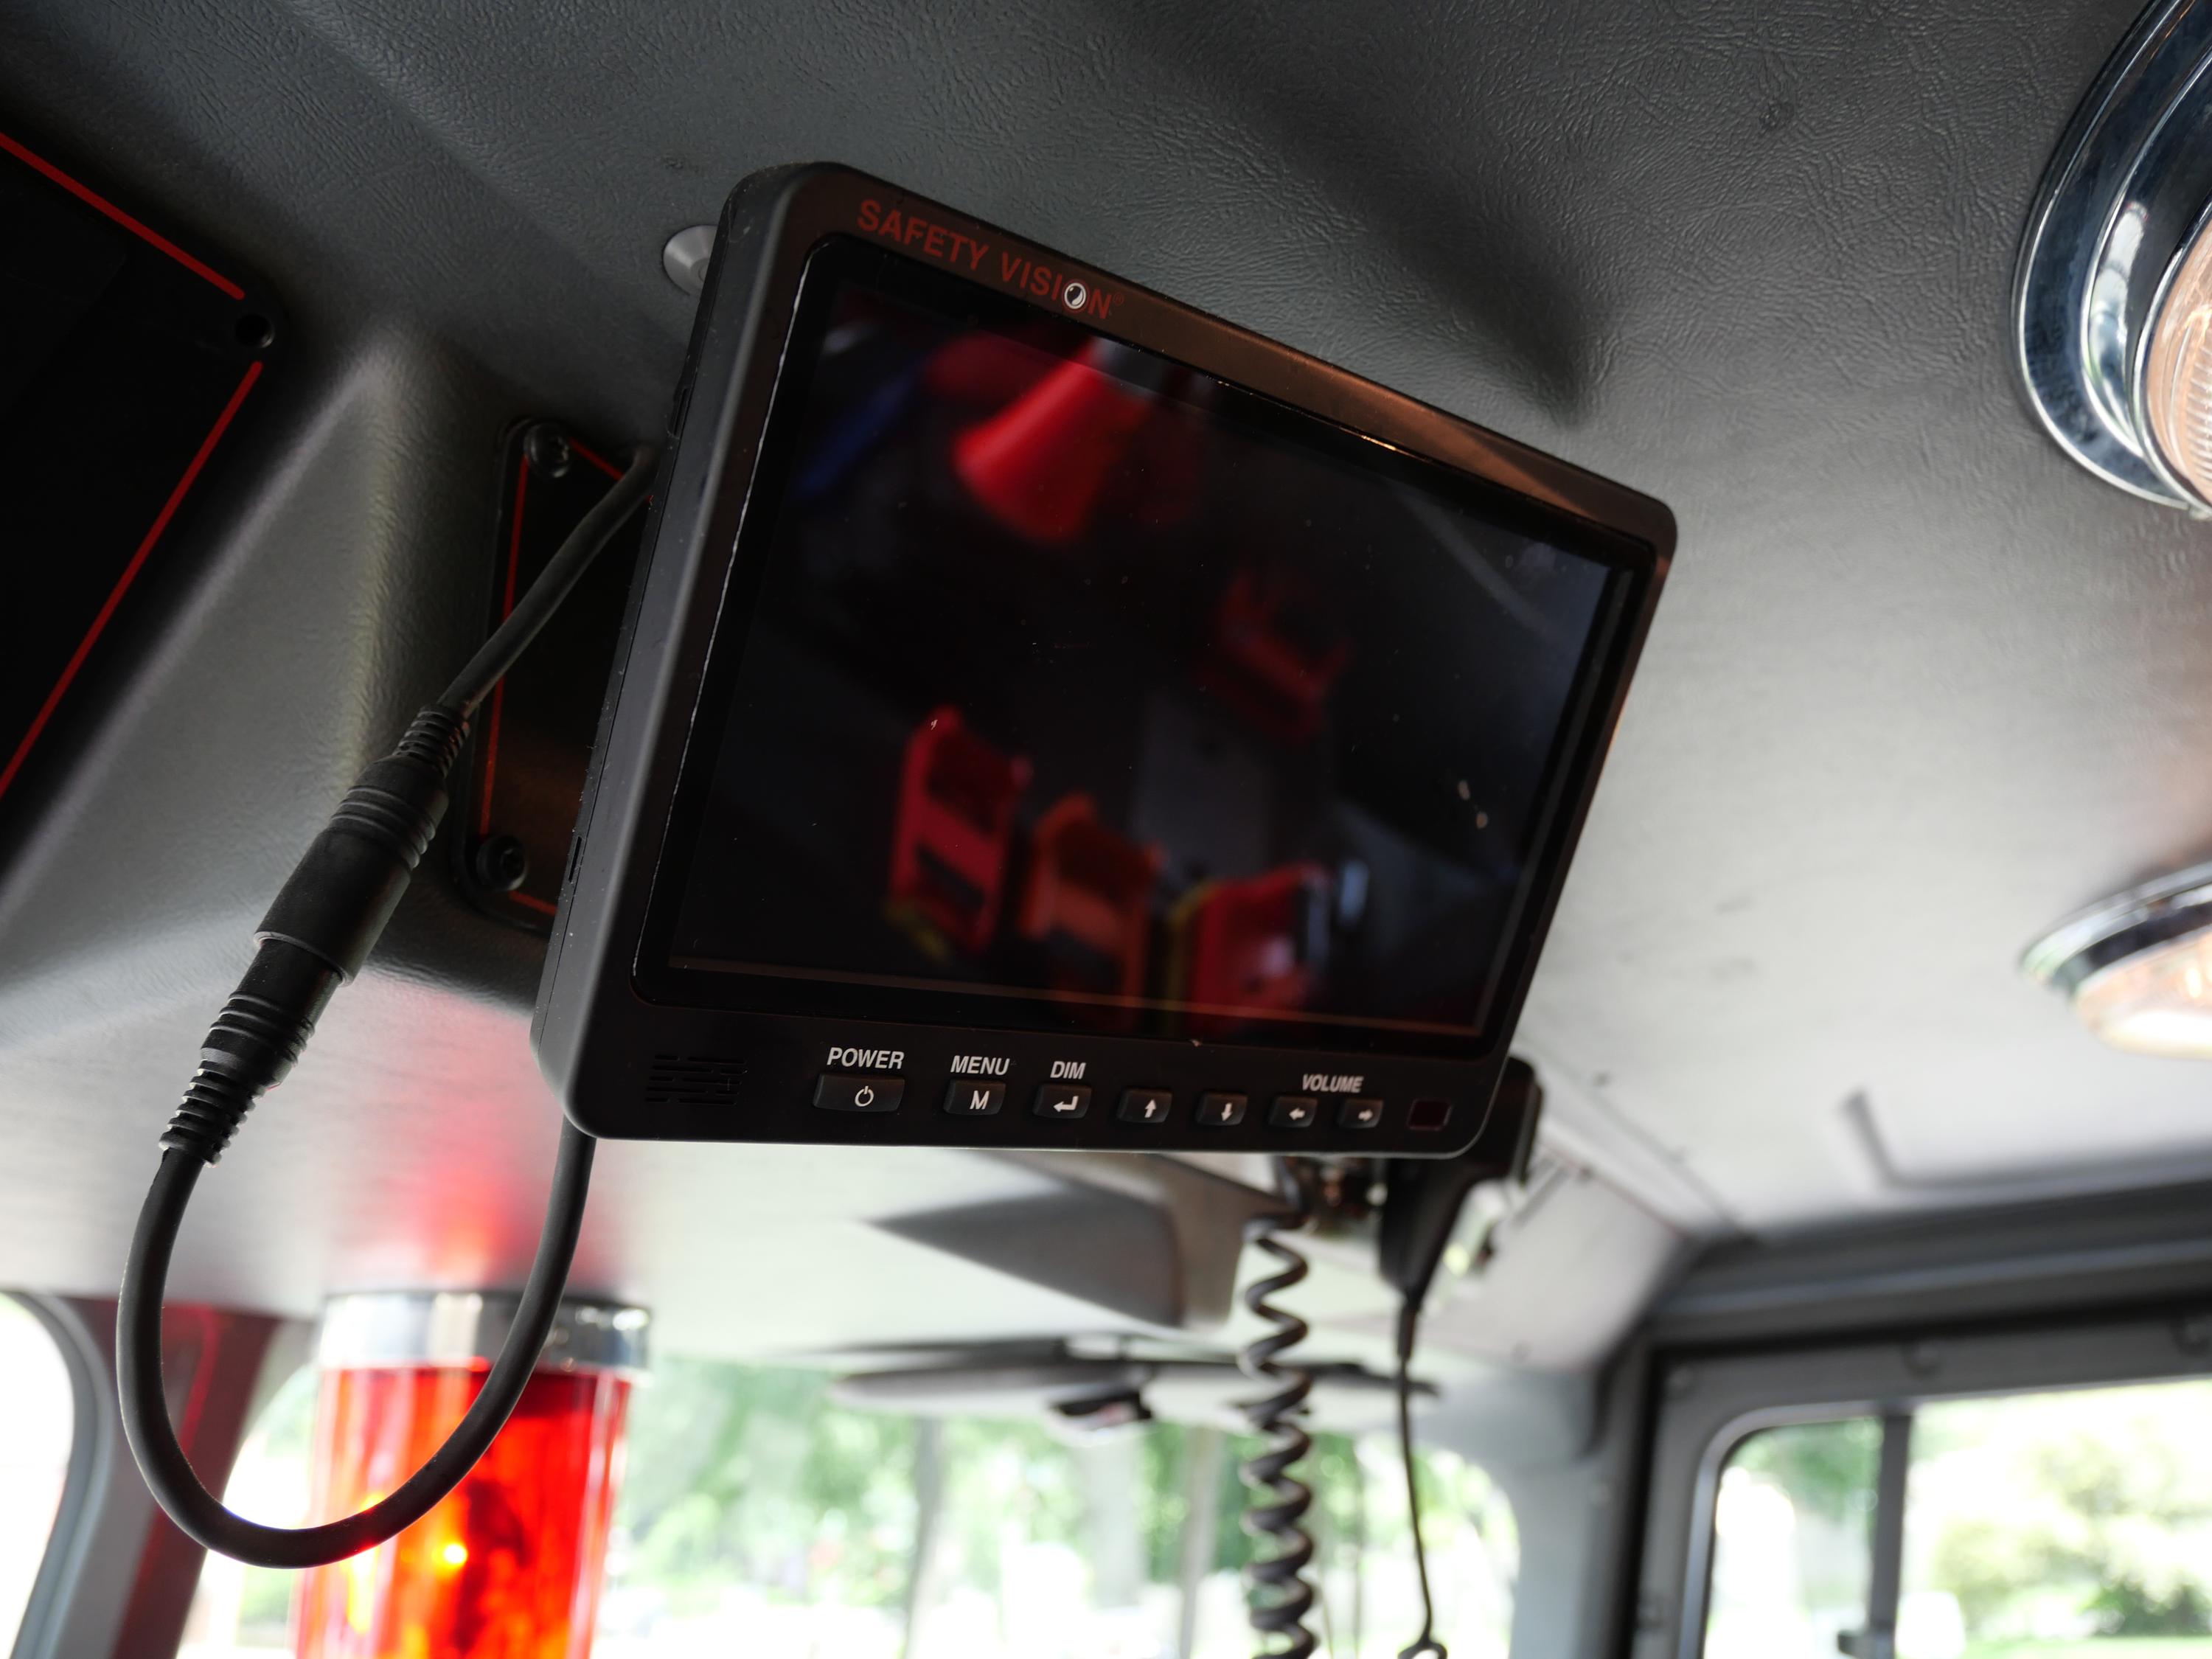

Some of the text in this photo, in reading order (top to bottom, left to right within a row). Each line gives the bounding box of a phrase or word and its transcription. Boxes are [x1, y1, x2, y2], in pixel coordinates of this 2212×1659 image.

[857, 199, 990, 271] SAFETY
[827, 1047, 905, 1070] POWER
[950, 1055, 1010, 1076] MENU
[1050, 1061, 1087, 1080] DIM
[1302, 1074, 1364, 1093] VOLUME
[970, 1091, 990, 1110] M
